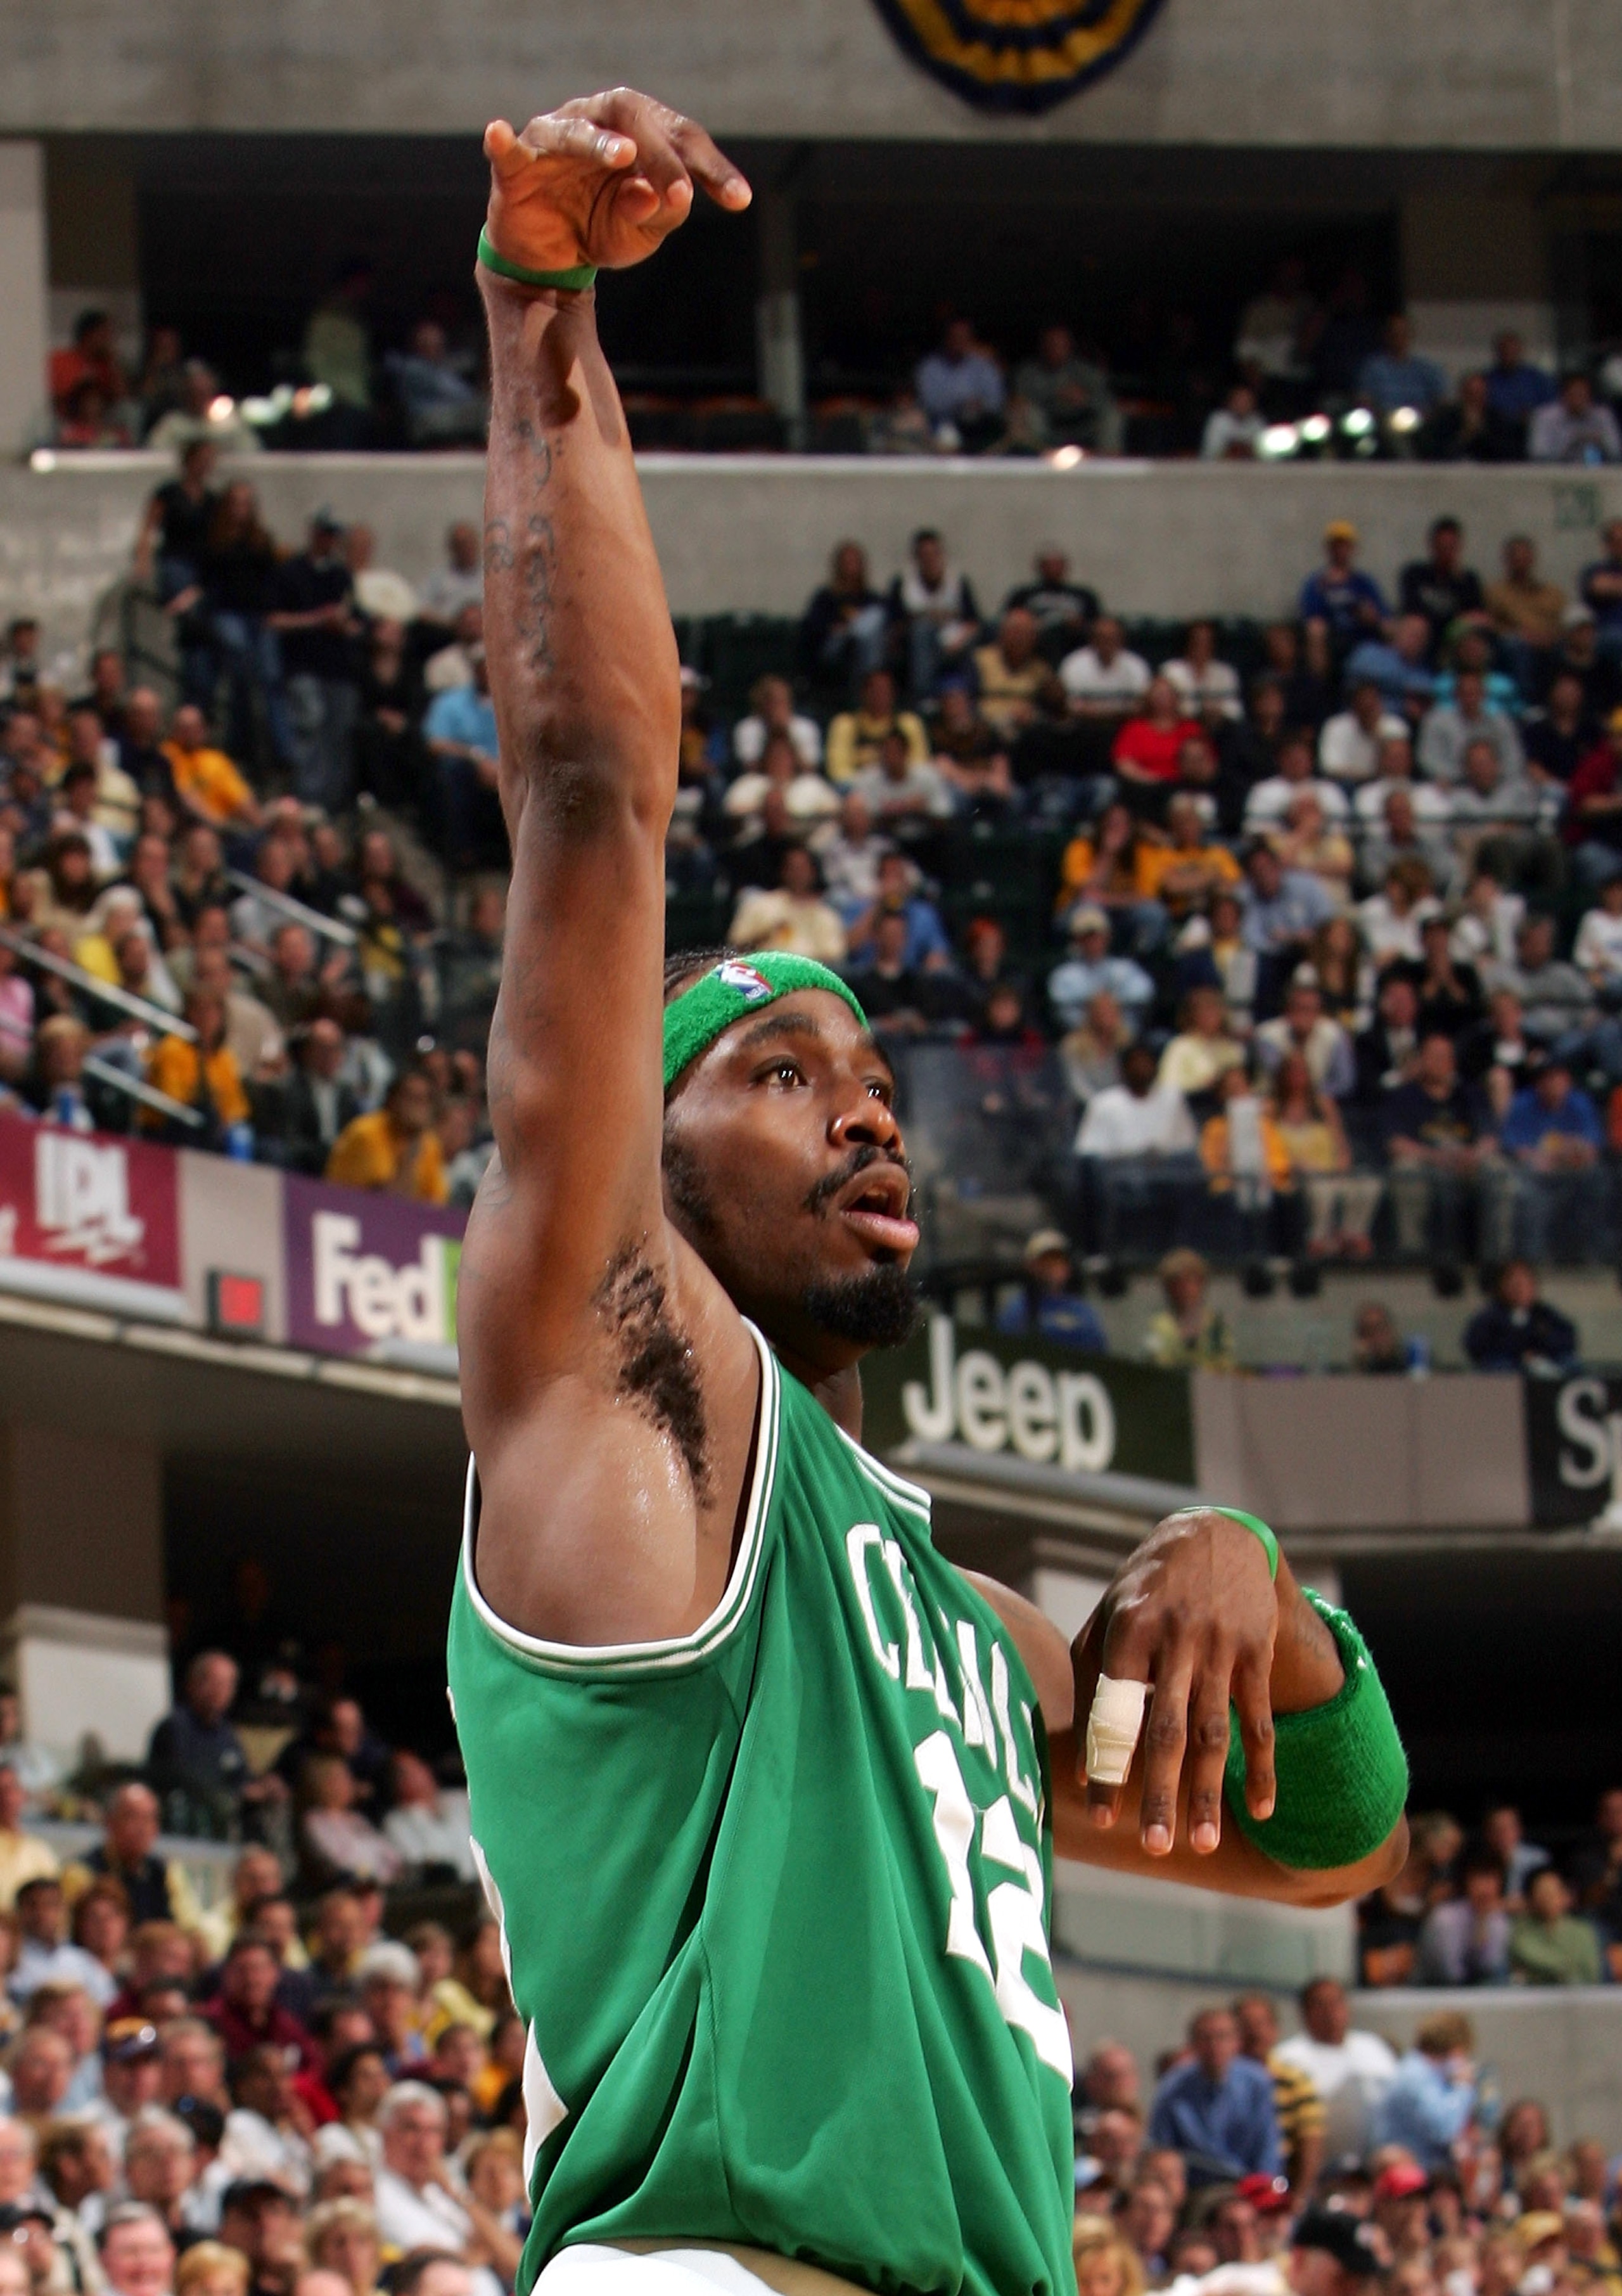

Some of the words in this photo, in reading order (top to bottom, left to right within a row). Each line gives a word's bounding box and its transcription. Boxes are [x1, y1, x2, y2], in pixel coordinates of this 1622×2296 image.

[902, 1314, 1115, 1474] Jeep
[846, 1523, 1045, 1845] CELTIC
[914, 1729, 1073, 2093] 12
